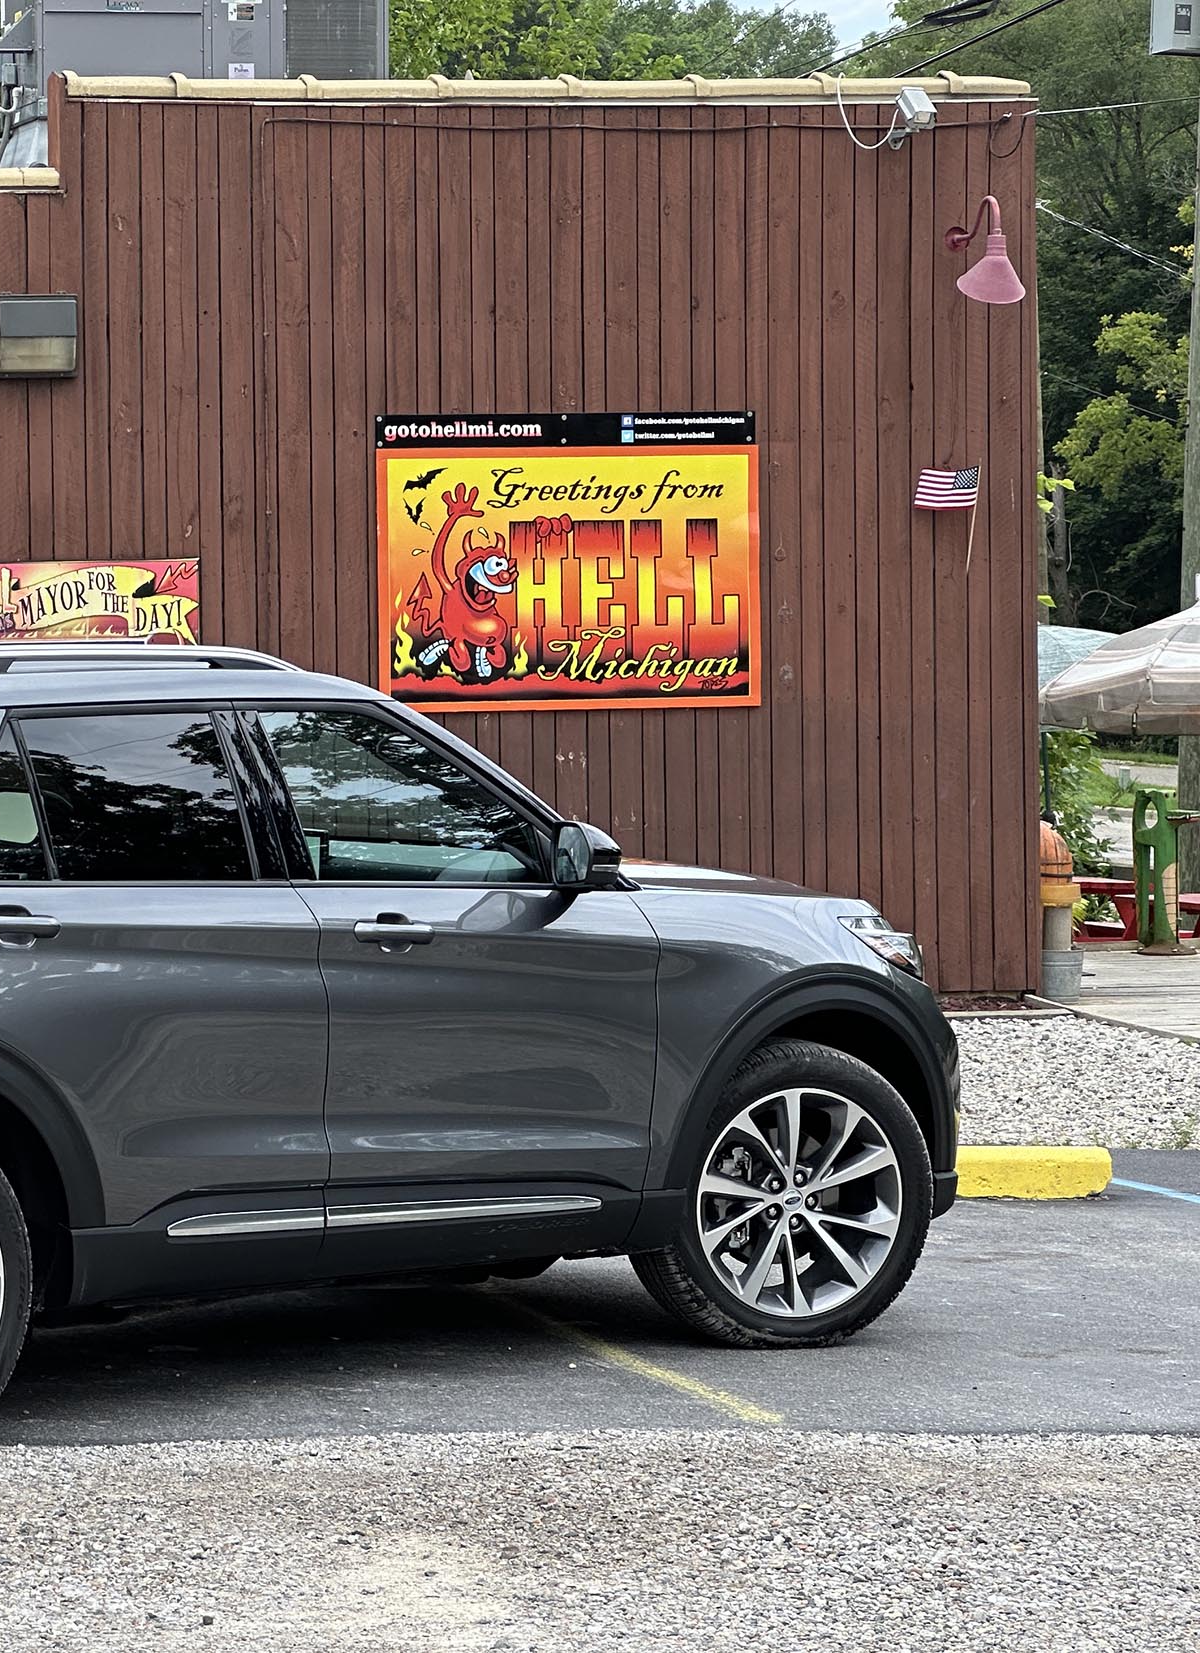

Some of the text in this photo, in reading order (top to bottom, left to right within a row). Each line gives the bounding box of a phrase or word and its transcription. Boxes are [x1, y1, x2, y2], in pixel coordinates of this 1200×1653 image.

[384, 420, 543, 441] gotohellmi.com
[486, 467, 724, 513] Greetings from
[18, 571, 183, 632] MAYOR FOR THE DAY!
[508, 517, 742, 664] HELL
[537, 626, 739, 692] Michigan
